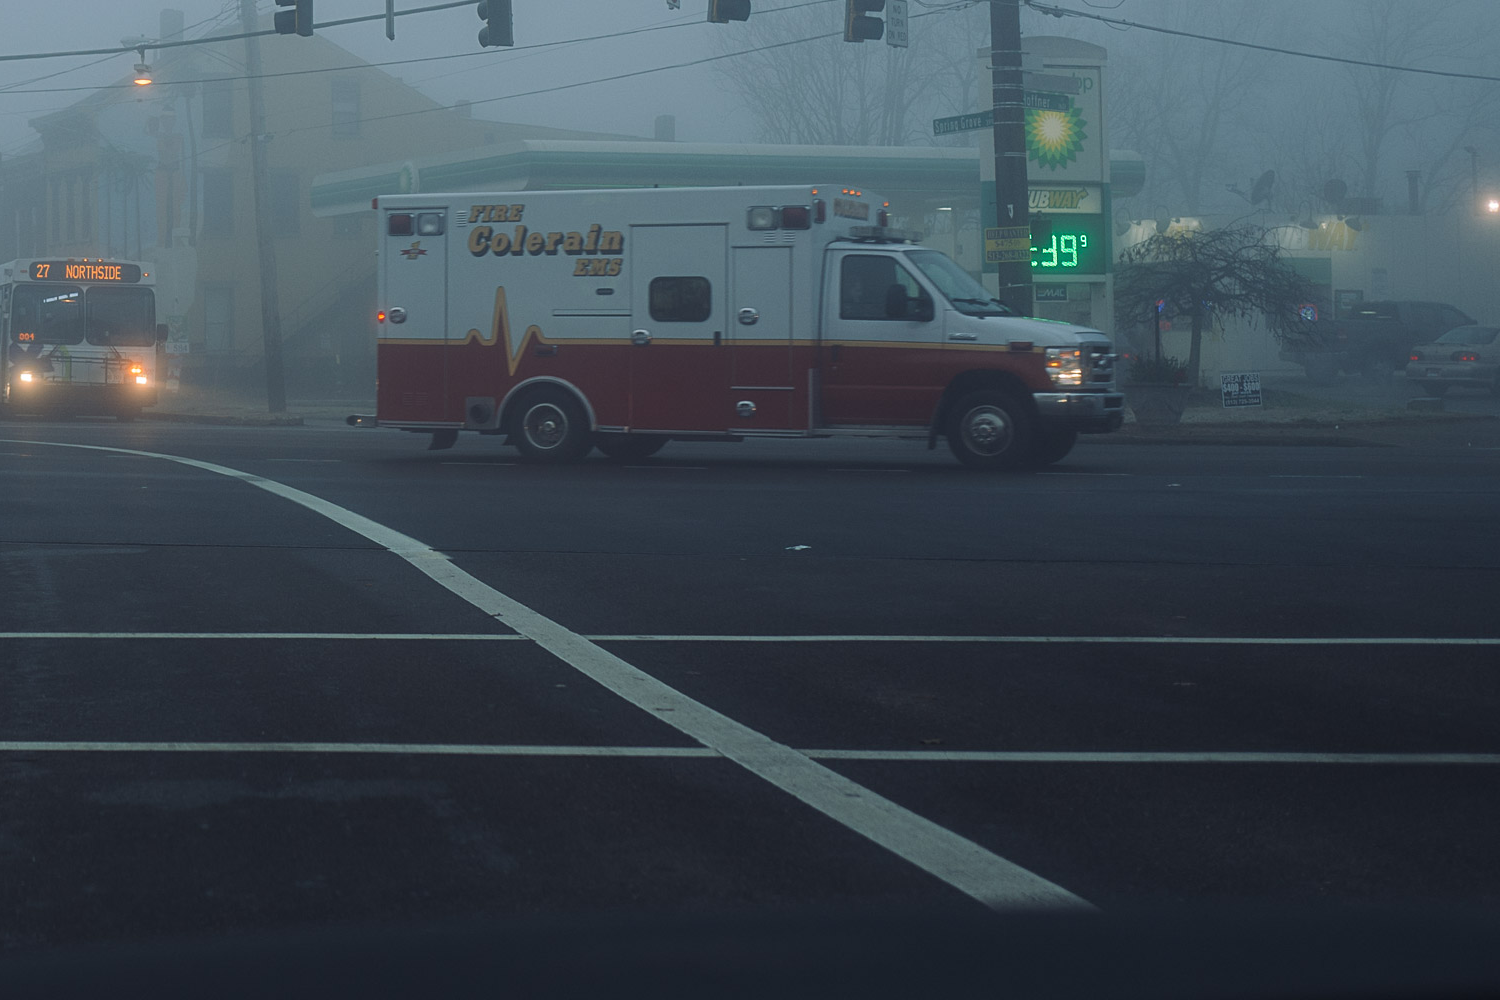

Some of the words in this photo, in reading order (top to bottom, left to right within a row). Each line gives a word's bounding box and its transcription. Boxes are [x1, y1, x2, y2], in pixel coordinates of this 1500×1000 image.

[892, 5, 902, 15] NO
[890, 17, 904, 28] TURN
[888, 30, 895, 40] ON
[897, 31, 907, 42] RED
[934, 119, 959, 133] Spring
[960, 116, 982, 129] Grove
[1028, 187, 1088, 209] UBWAY
[468, 204, 525, 223] FIRE
[468, 223, 625, 257] Colerain
[36, 263, 50, 278] 27
[65, 264, 122, 280] NORTHSIDE
[573, 258, 624, 277] EMS
